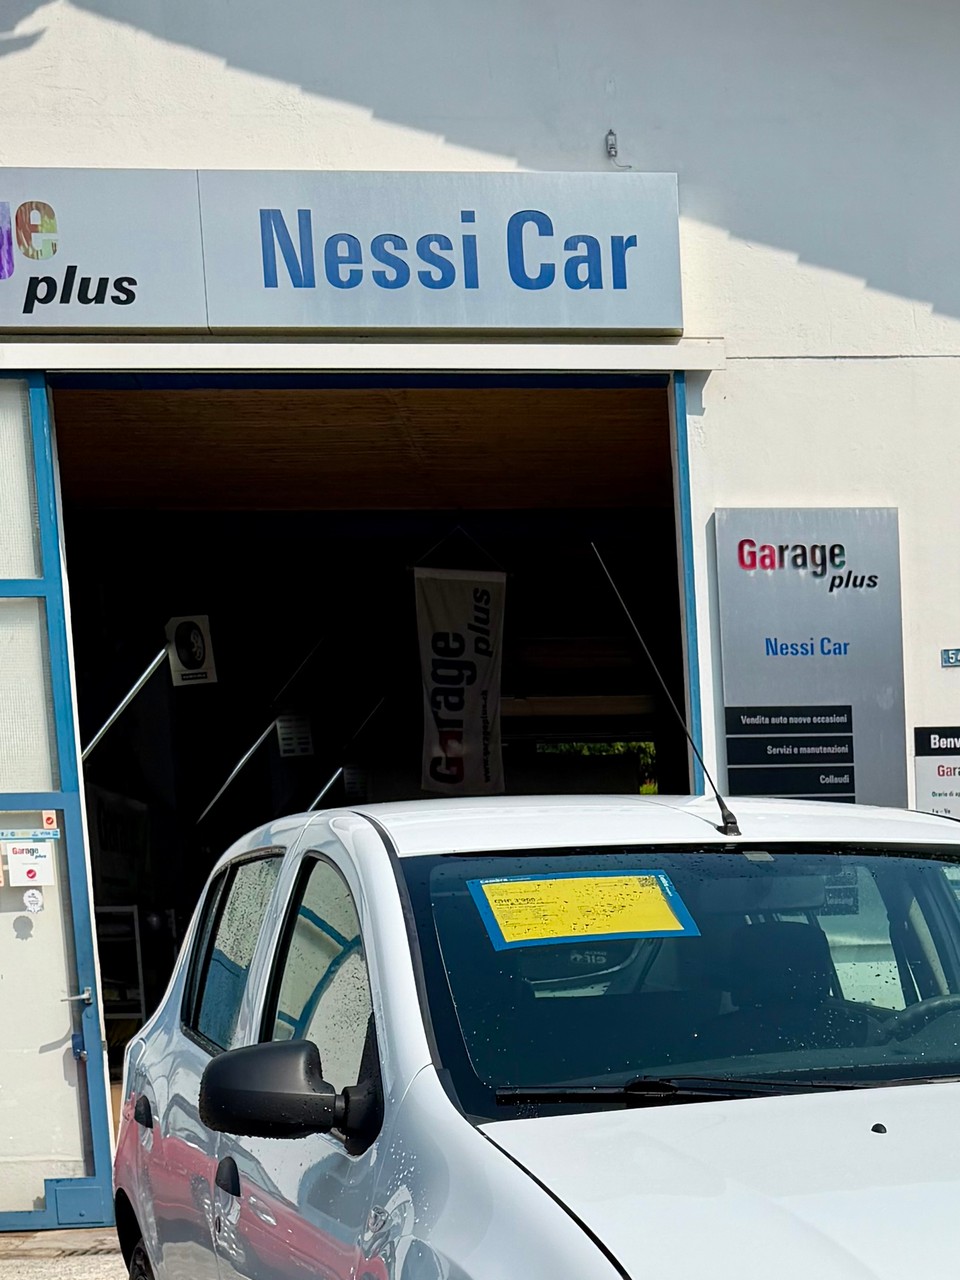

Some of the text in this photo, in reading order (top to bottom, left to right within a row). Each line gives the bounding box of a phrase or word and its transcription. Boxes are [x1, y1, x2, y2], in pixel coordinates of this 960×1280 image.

[258, 208, 637, 291] Nessi Car
[22, 265, 137, 313] plus
[737, 538, 846, 578] Garage
[828, 570, 879, 592] plus
[467, 587, 493, 658] plus
[765, 637, 850, 656] Nessi Car
[429, 631, 477, 784] Garage
[740, 715, 770, 725] Vendita
[771, 716, 788, 724] auto
[812, 714, 848, 724] occasioni
[766, 745, 792, 755] Servizi
[799, 744, 849, 754] manutenzioni
[819, 774, 850, 784] Collaudi
[12, 847, 39, 856] Garage
